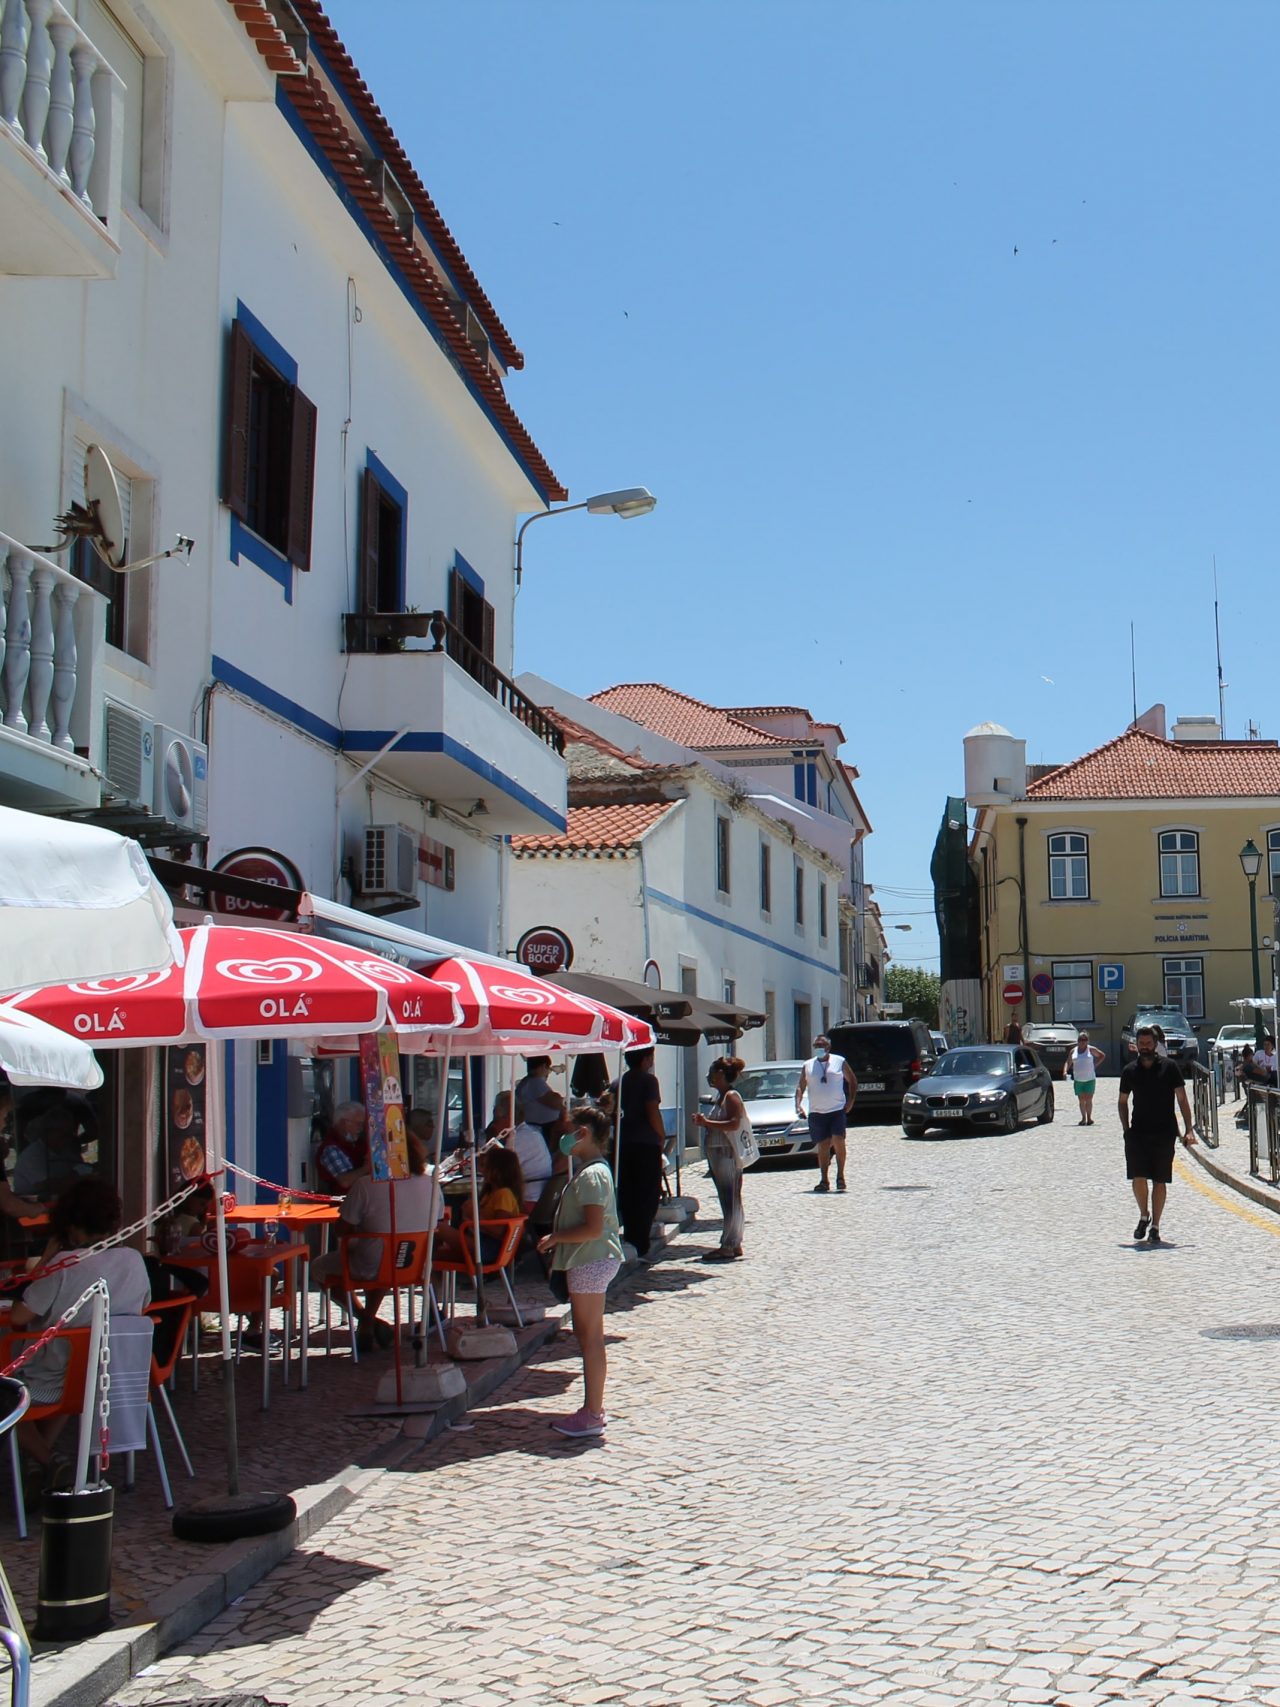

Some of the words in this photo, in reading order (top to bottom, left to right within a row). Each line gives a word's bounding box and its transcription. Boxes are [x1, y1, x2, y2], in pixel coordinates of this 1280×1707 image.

[527, 943, 559, 955] SUPER
[528, 953, 557, 964] BOCK
[1103, 967, 1119, 988] P
[259, 992, 309, 1018] OLÁ
[73, 1007, 125, 1033] OLÁ
[520, 1011, 551, 1027] OLÁ
